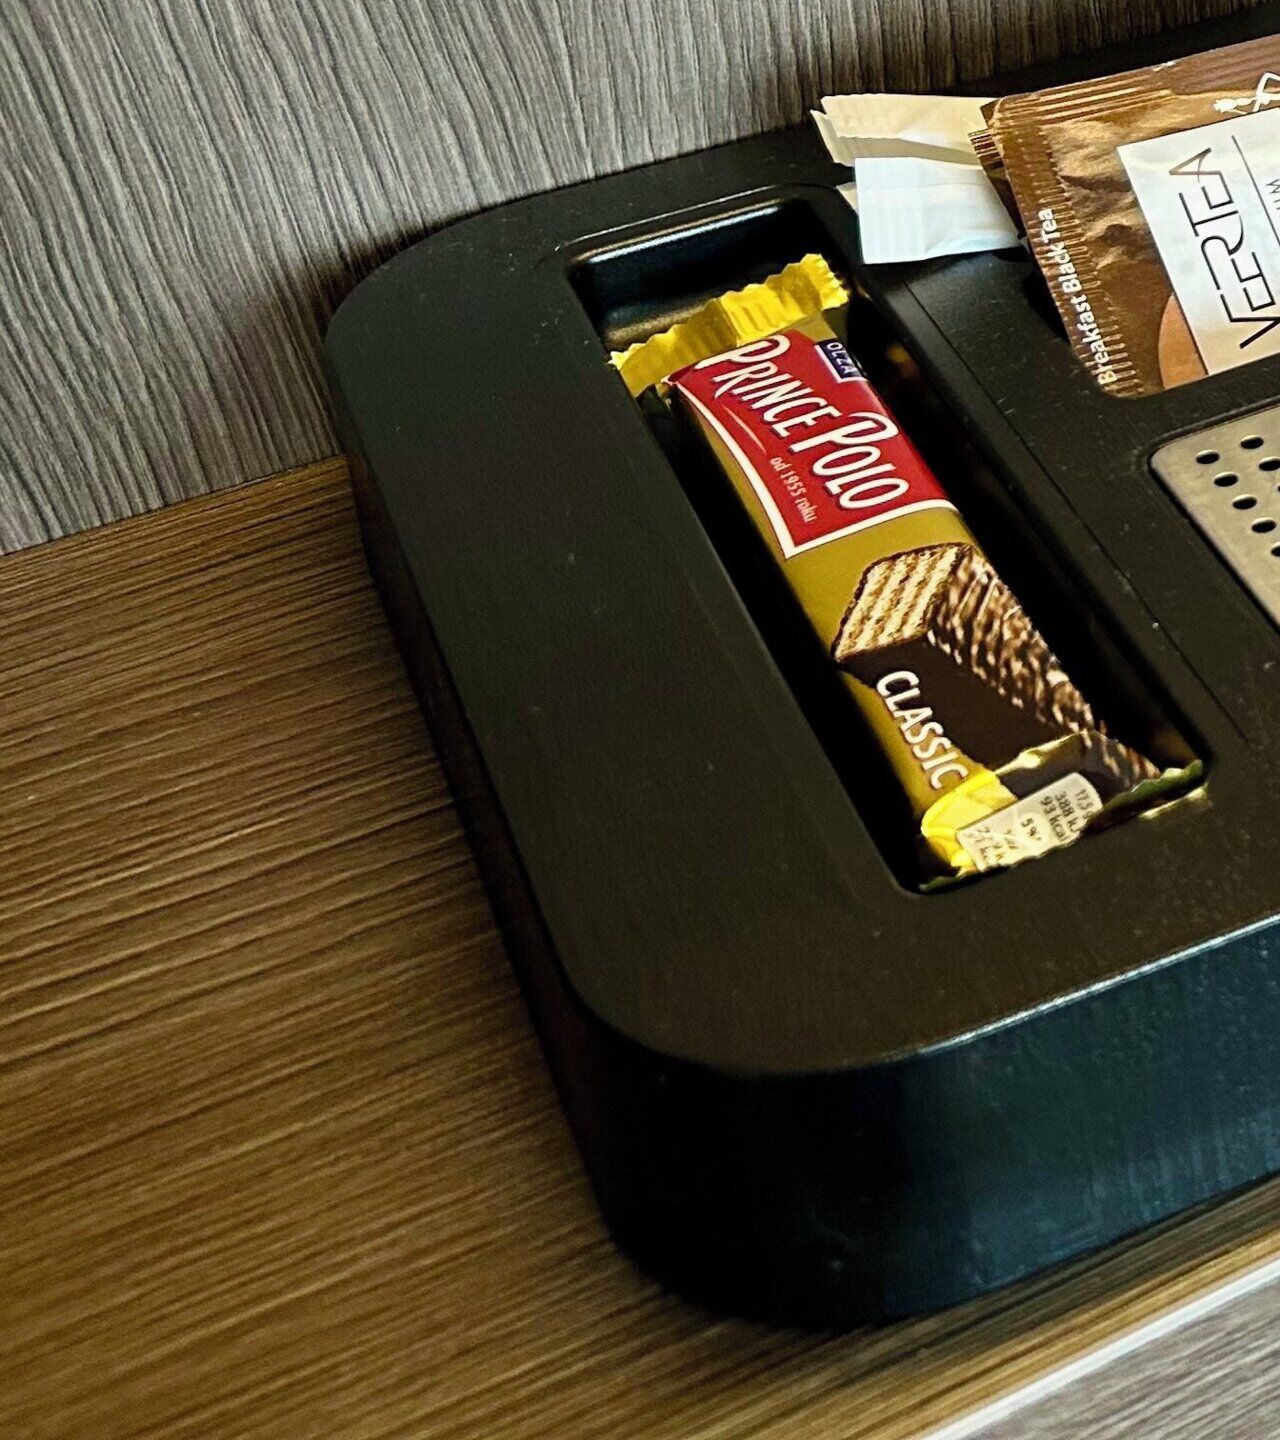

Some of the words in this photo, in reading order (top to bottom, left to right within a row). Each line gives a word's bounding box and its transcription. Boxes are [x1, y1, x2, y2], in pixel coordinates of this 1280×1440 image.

[1037, 208, 1061, 244] Tea
[1046, 241, 1083, 294] Black
[1069, 293, 1118, 385] Breakfast
[826, 341, 858, 374] OLZA
[693, 334, 843, 438] PRINCE
[769, 456, 792, 472] od
[780, 470, 808, 497] 1955
[794, 497, 818, 523] roku
[876, 670, 970, 790] CLASSIC
[1049, 815, 1069, 841] kcal
